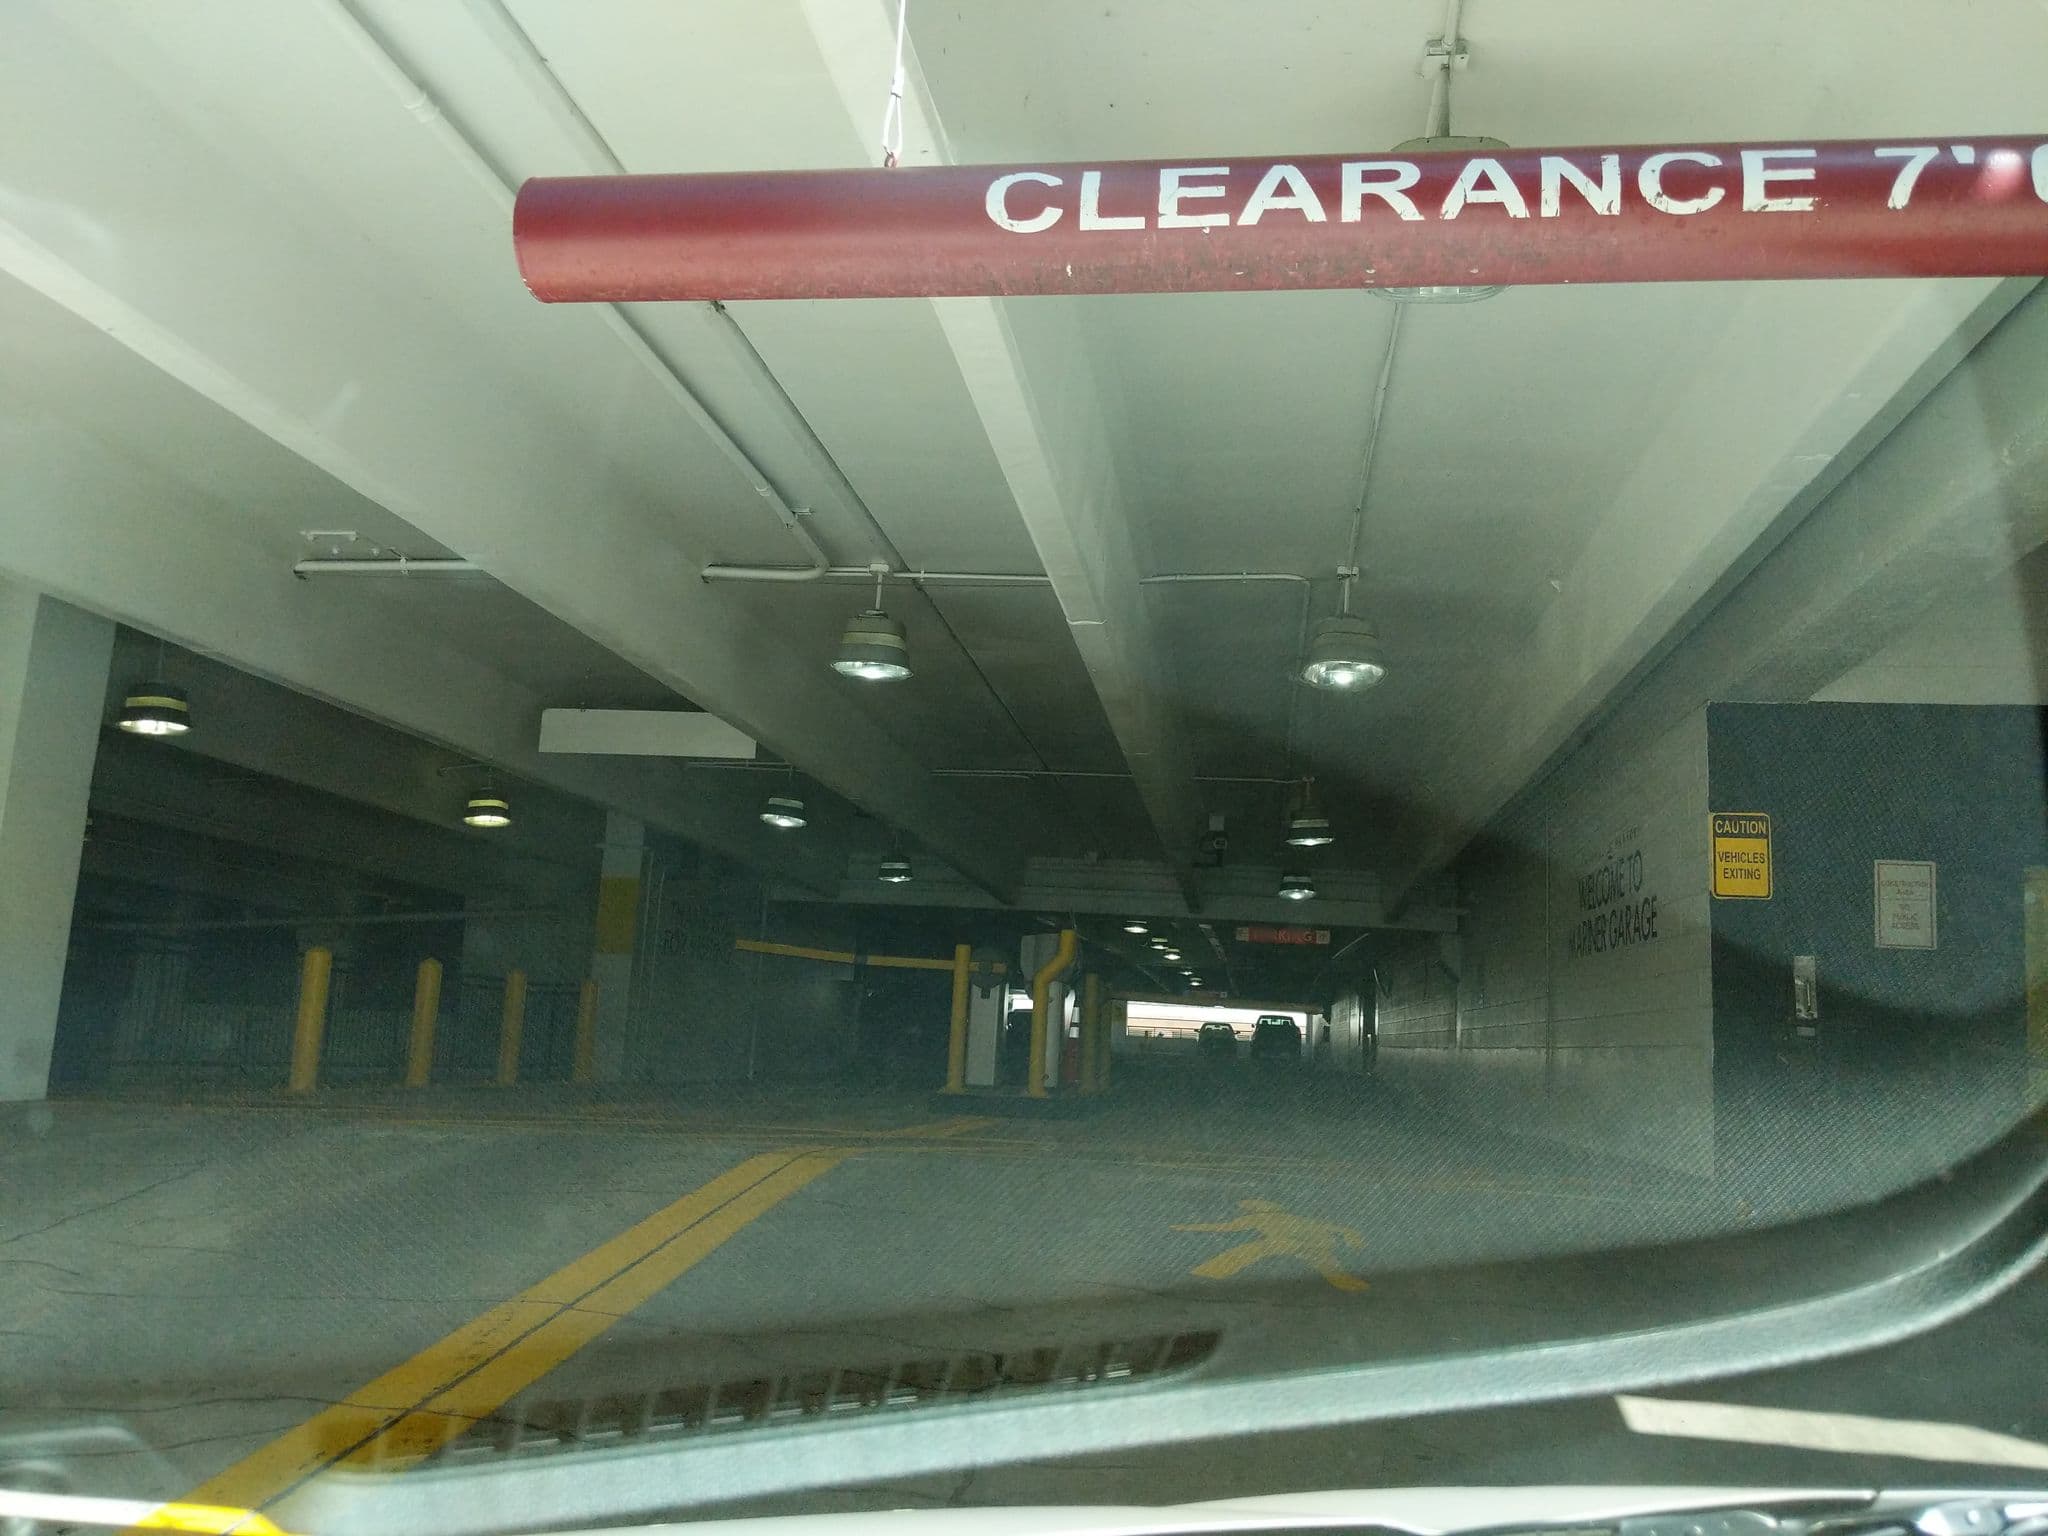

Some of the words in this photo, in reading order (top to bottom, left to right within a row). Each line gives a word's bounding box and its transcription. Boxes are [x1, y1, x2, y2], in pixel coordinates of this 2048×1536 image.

[983, 149, 1816, 234] CLEARANCE
[1715, 820, 1767, 834] CAUTION
[1626, 849, 1643, 896] TO
[1717, 851, 1766, 864] VEHICLES
[1722, 867, 1761, 880] EXITING
[1608, 893, 1657, 949] GARAGE
